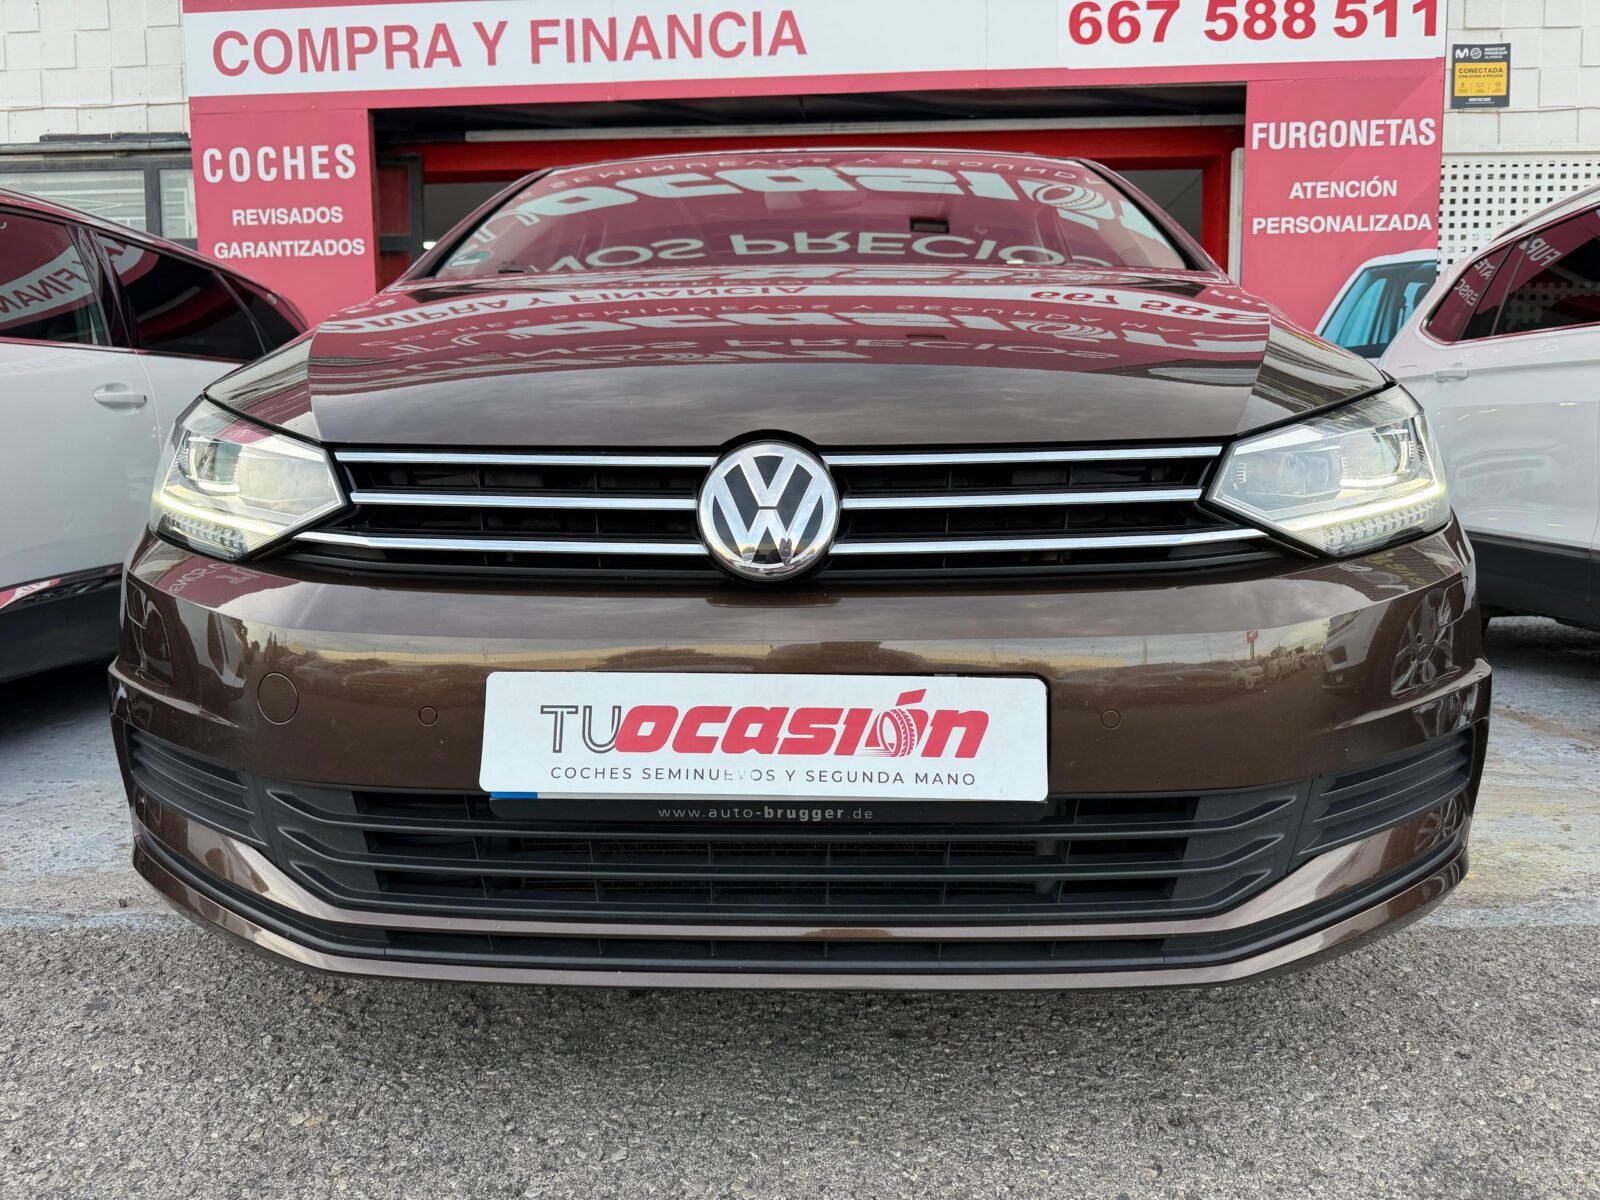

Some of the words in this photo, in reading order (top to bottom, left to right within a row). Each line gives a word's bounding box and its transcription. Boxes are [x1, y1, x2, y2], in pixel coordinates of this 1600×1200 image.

[1068, 0, 1181, 45] 667
[1203, 0, 1317, 42] 588
[1333, 0, 1438, 39] 511
[212, 22, 463, 77] COMPRA
[472, 21, 508, 66] Y
[529, 10, 808, 65] FINANCIA
[1252, 118, 1437, 150] FURGONETAS
[203, 144, 357, 183] COCHES
[1289, 176, 1398, 199] ATENCIÓN
[232, 206, 343, 226] REVISADOS
[1252, 214, 1432, 235] PERSONALIZADA
[214, 238, 365, 259] GARANTIZADOS
[551, 766, 633, 780] COCHES
[785, 769, 796, 781] Y
[805, 770, 905, 784] SEGUNDA
[915, 773, 976, 786] MANO
[658, 806, 873, 821] www.auto-brugger.de
